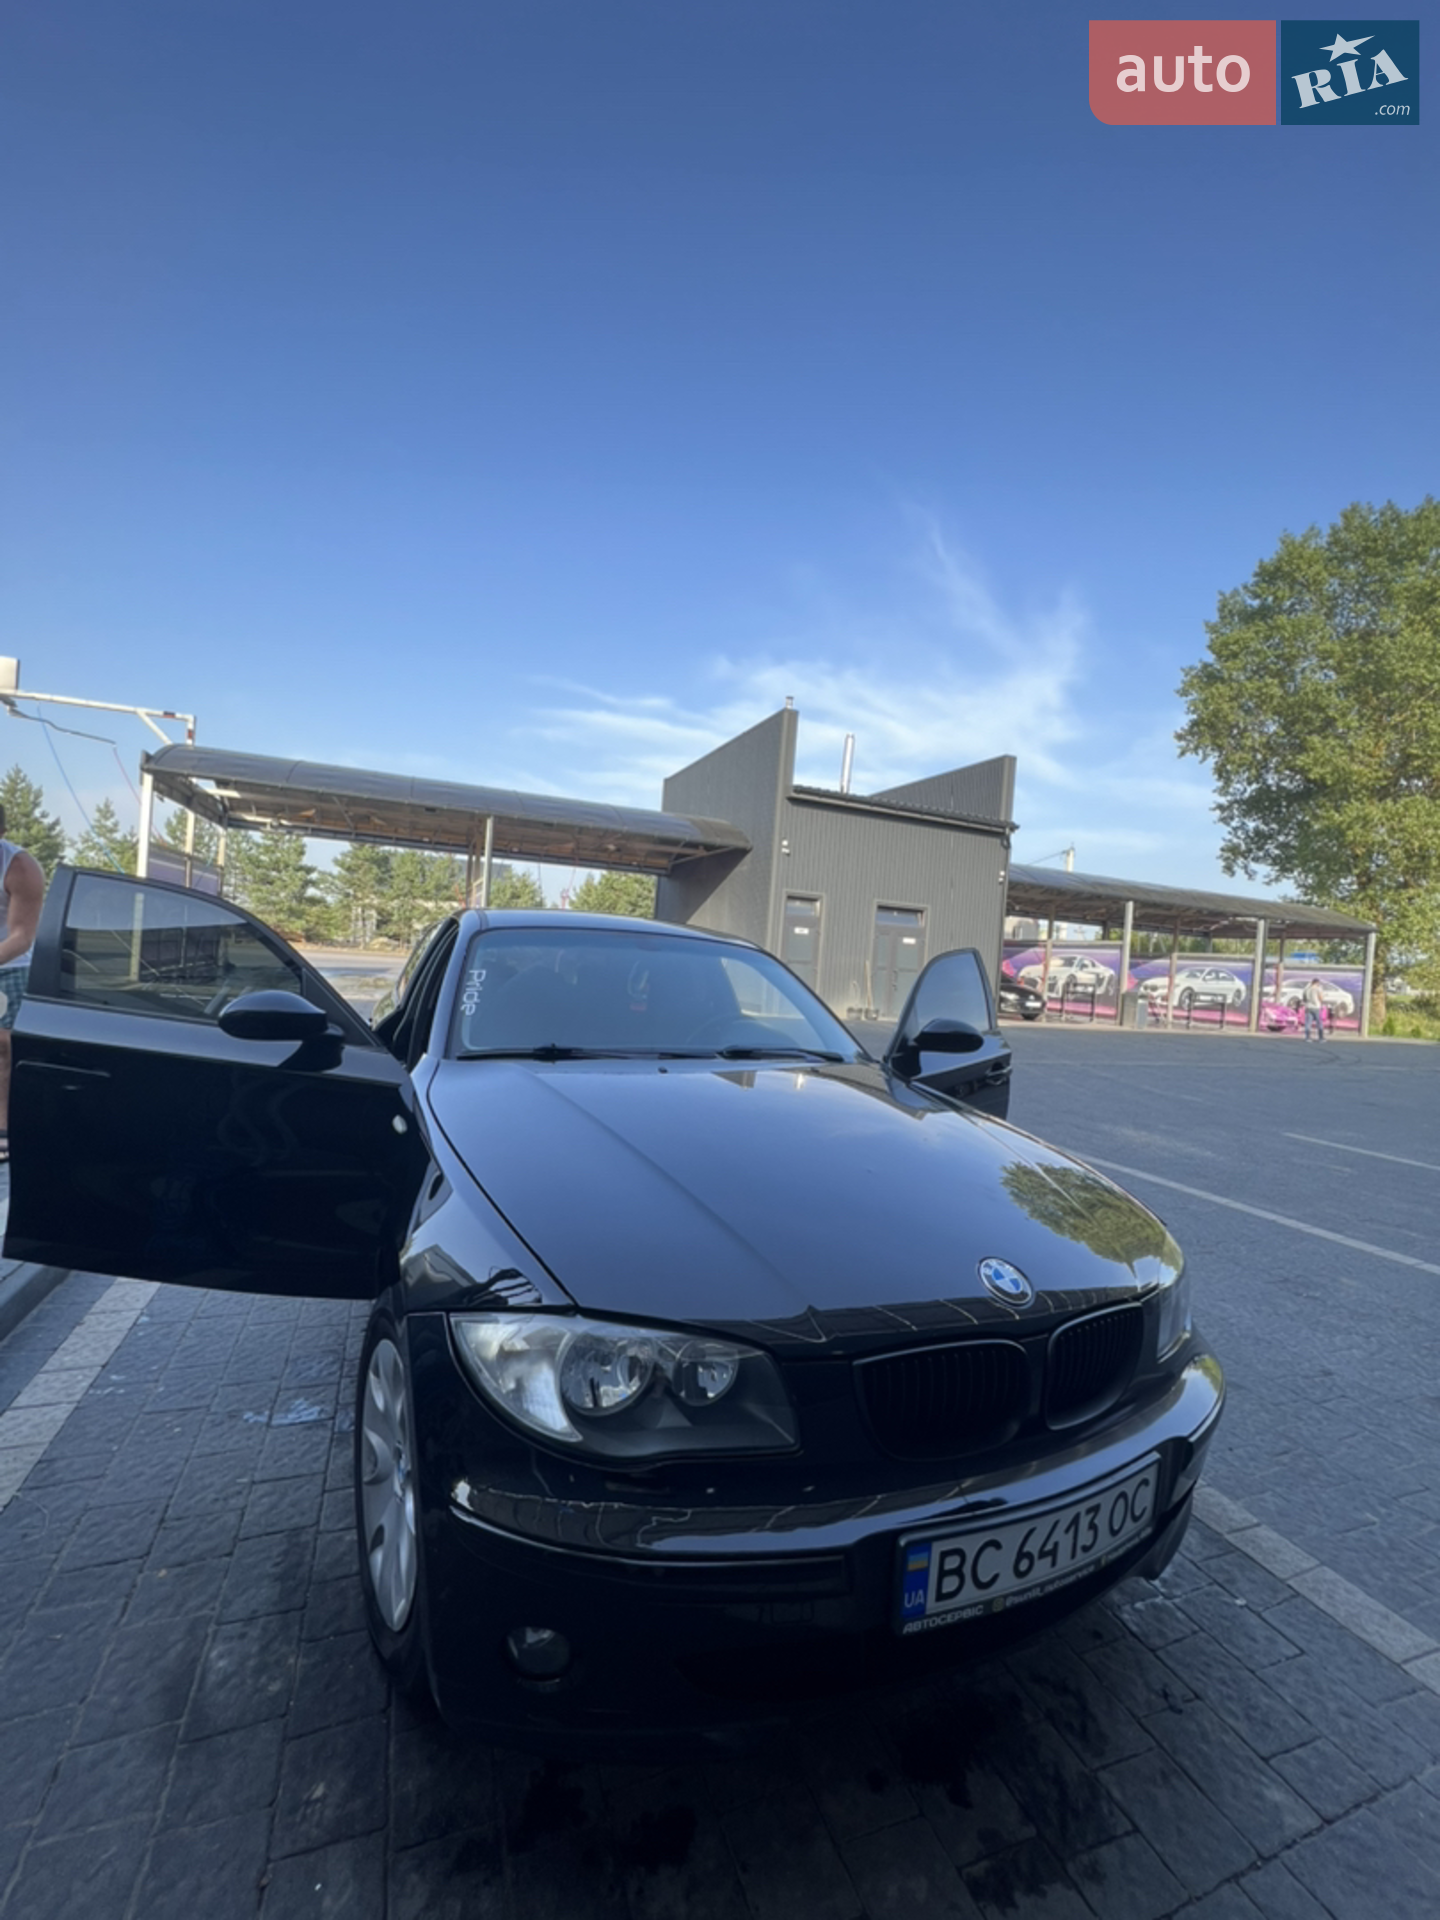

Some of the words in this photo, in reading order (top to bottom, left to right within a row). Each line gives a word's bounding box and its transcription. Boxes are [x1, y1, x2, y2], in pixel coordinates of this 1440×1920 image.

[460, 969, 487, 1016] Pride
[934, 1538, 1003, 1603] BC
[1012, 1502, 1102, 1580] 6413
[1108, 1477, 1150, 1537] OC
[903, 1588, 925, 1608] UA
[902, 1604, 984, 1635] АВТОСЕРВІС
